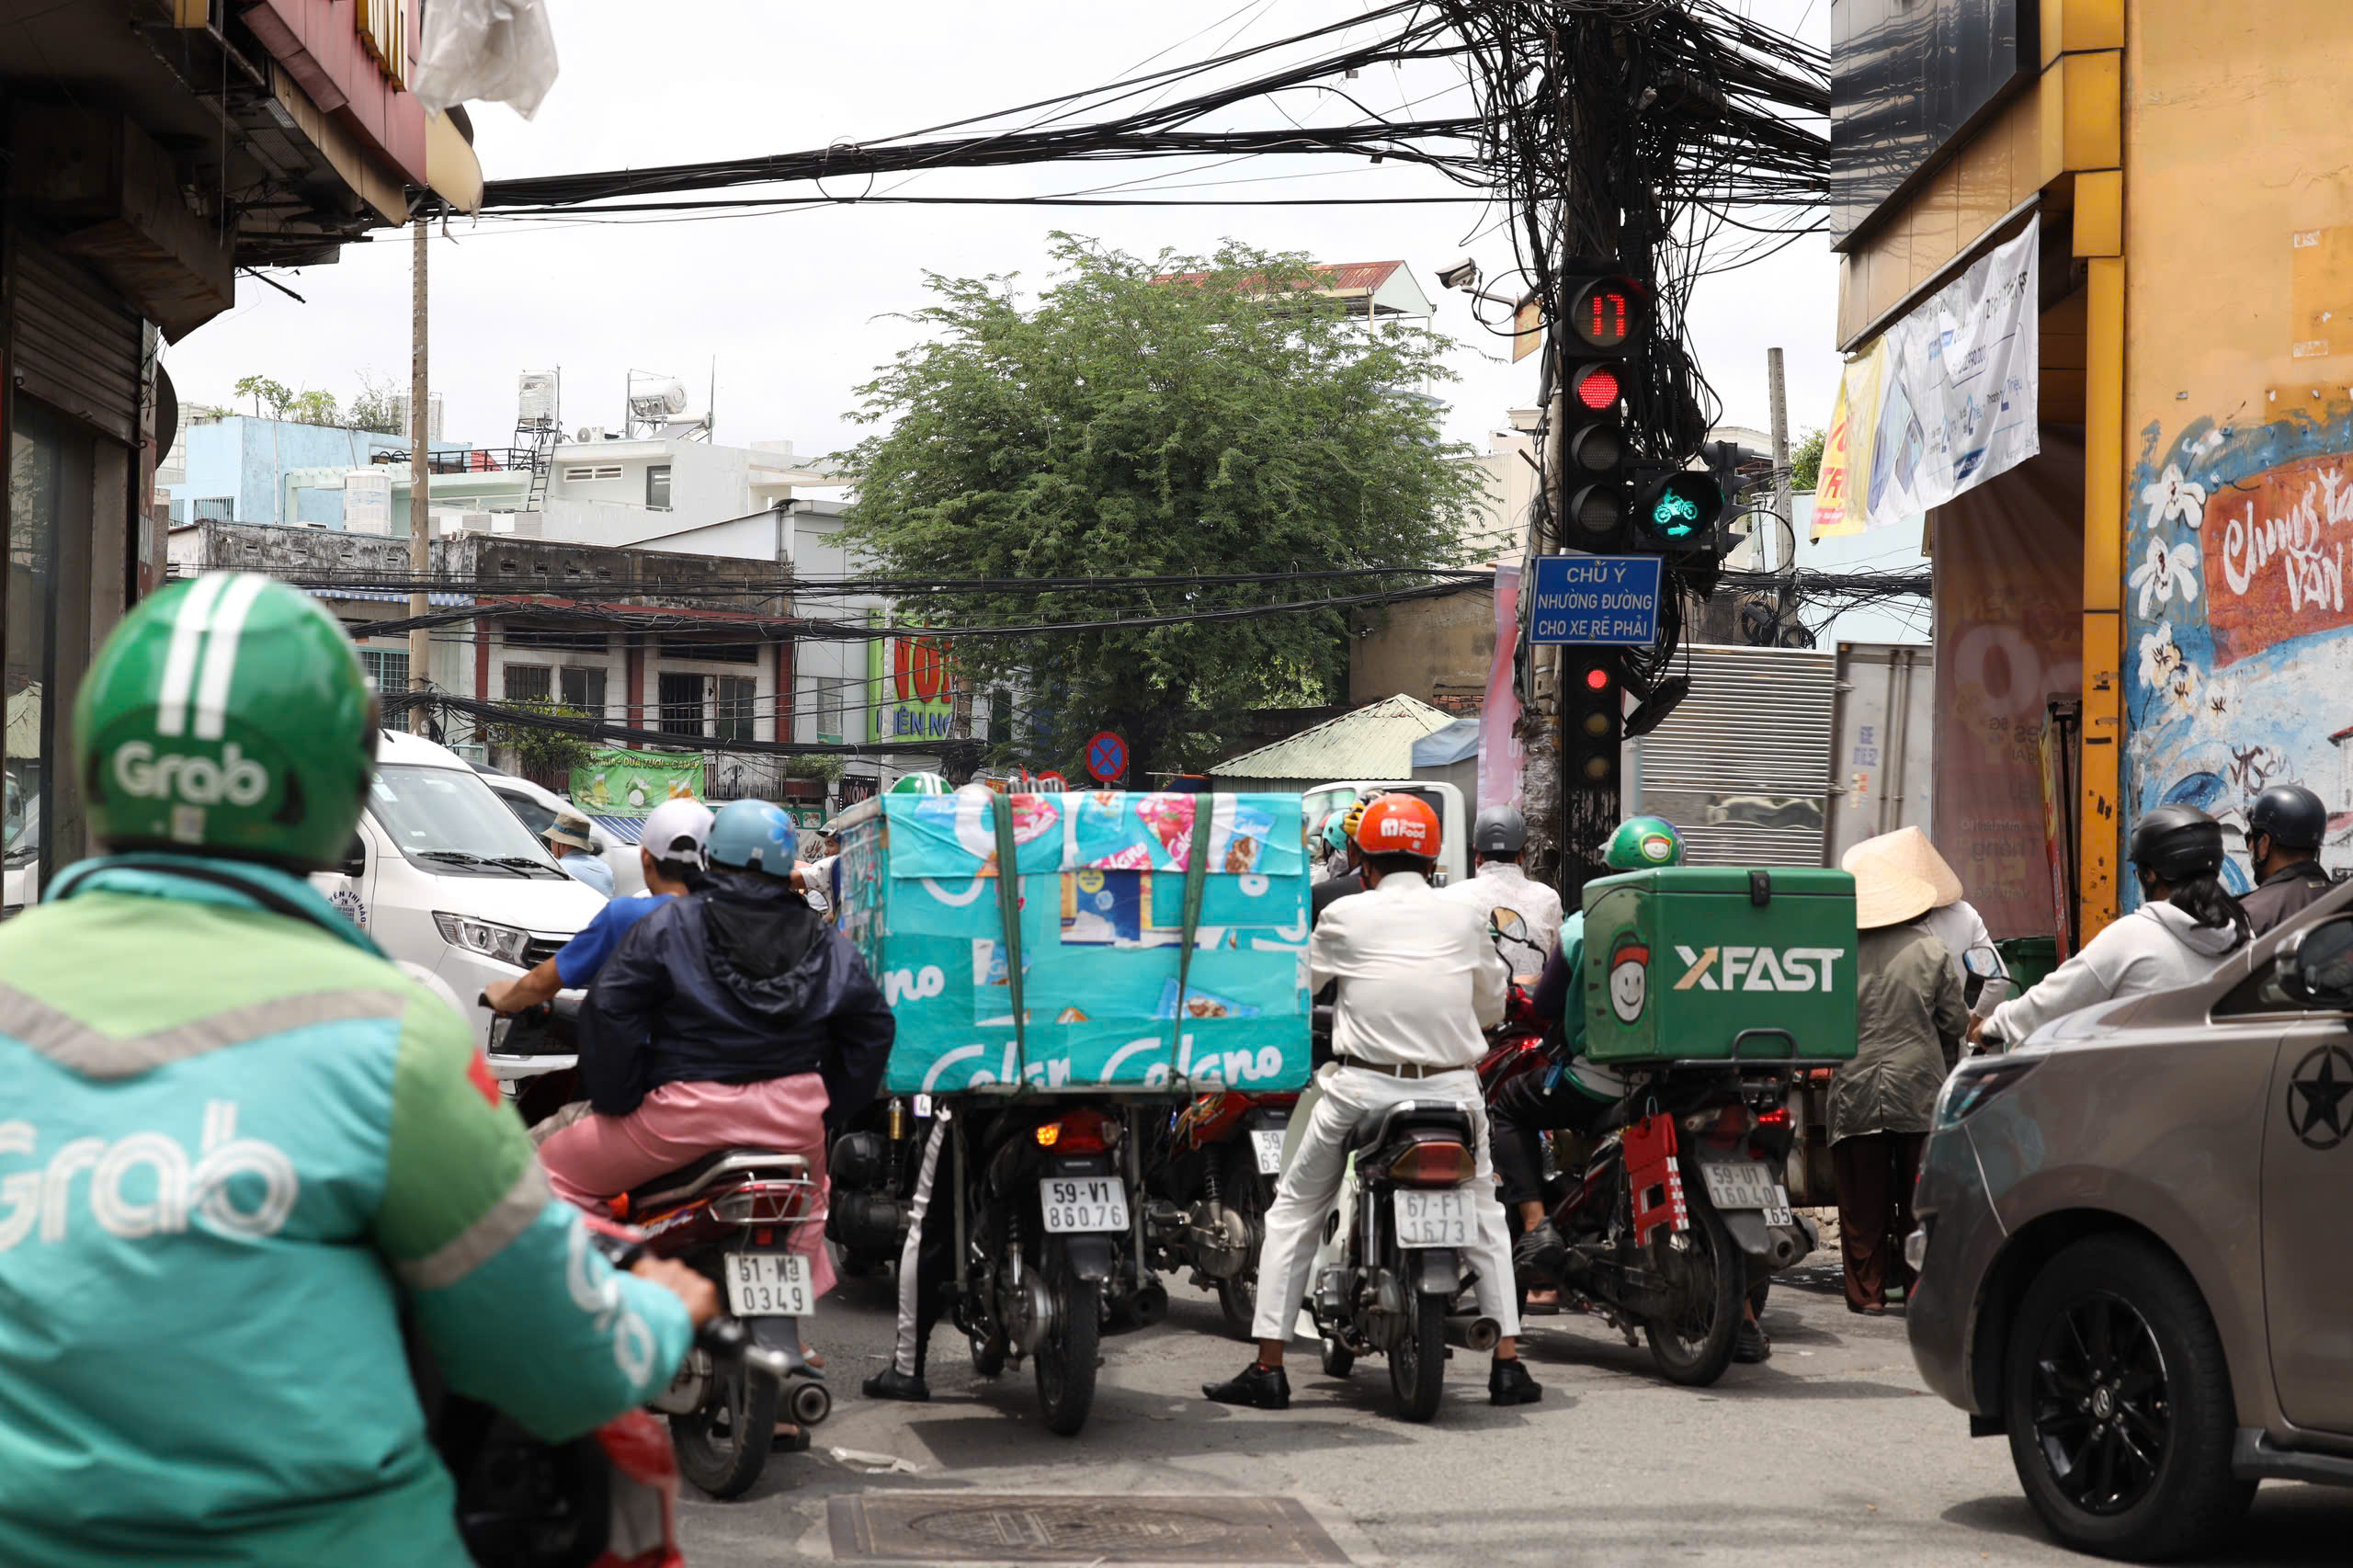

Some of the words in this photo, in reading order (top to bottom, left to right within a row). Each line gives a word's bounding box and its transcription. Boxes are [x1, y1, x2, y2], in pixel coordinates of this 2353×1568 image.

[1592, 293, 1626, 337] 17
[1566, 561, 1608, 584] CHÚ
[1614, 562, 1626, 584] Ý
[1538, 588, 1597, 610] NHƯỜNG
[1601, 588, 1653, 610] ĐƯỜNG
[1538, 619, 1566, 636] CHO
[1569, 619, 1588, 636] XE
[1590, 615, 1610, 636] RẼ
[1613, 614, 1647, 637] PHẢI
[113, 739, 270, 808] Grab
[1672, 945, 1846, 993] XFAST
[1052, 1182, 1109, 1204] 59-V1
[1050, 1205, 1122, 1228] 860.76
[1406, 1194, 1463, 1218] 67-F1
[743, 1287, 803, 1312] 0349
